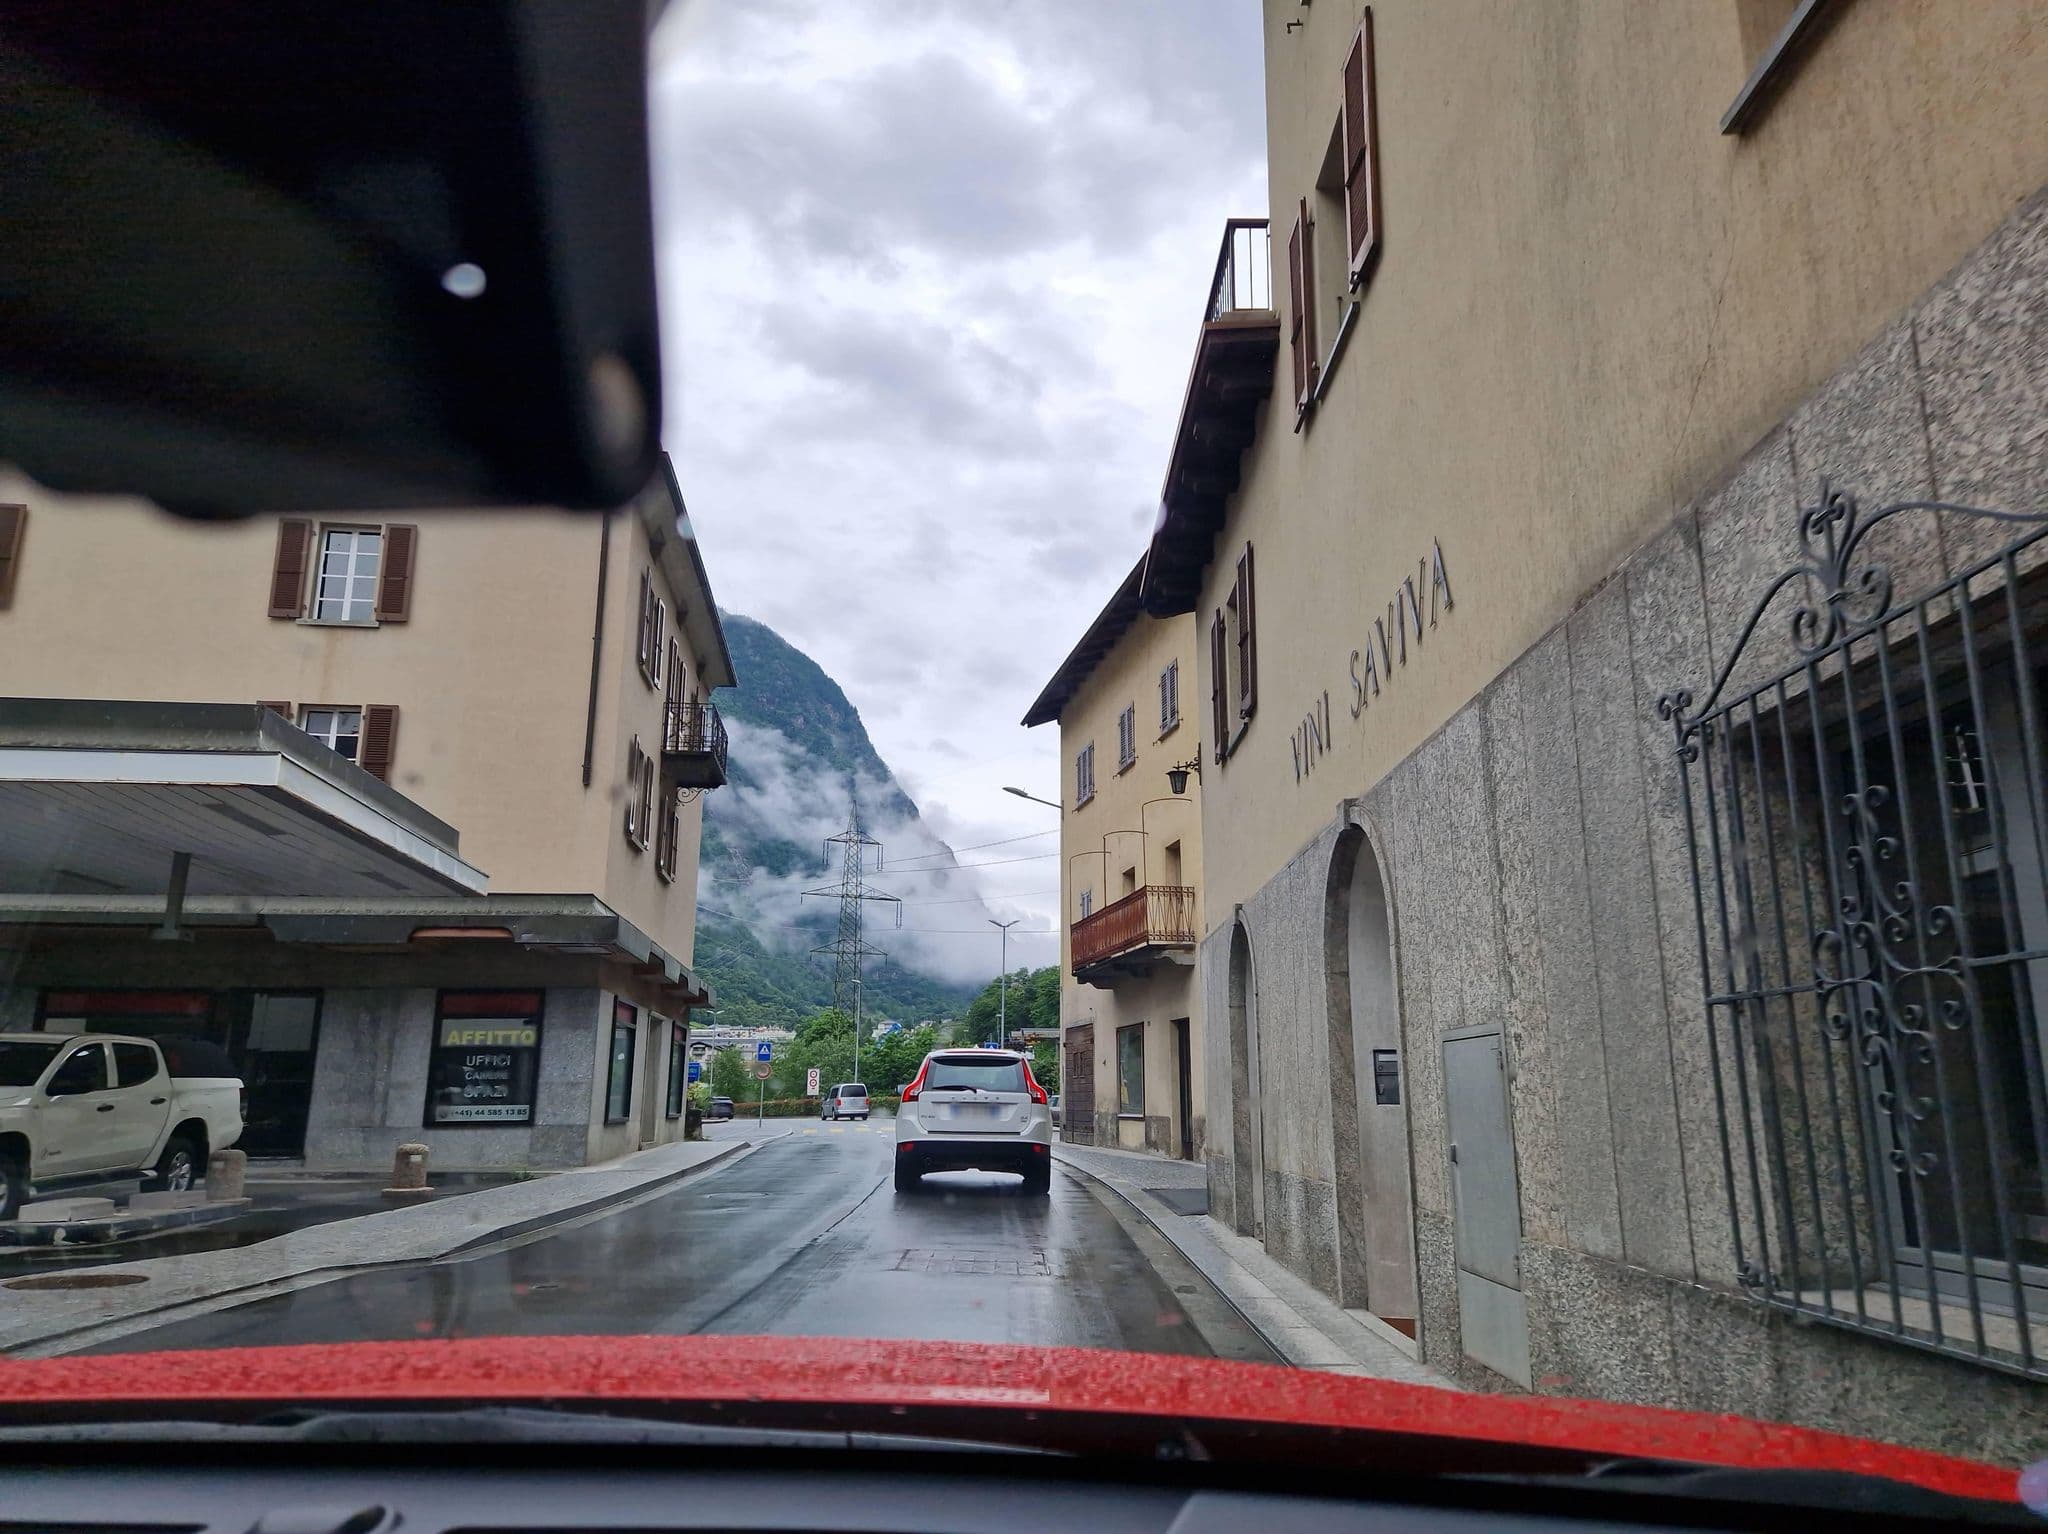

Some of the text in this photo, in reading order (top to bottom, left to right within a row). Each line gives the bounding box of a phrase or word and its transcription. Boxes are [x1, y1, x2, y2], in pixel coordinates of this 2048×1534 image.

[1290, 536, 1454, 787] VINI SAVIVA
[447, 1030, 535, 1046] AFFITTO
